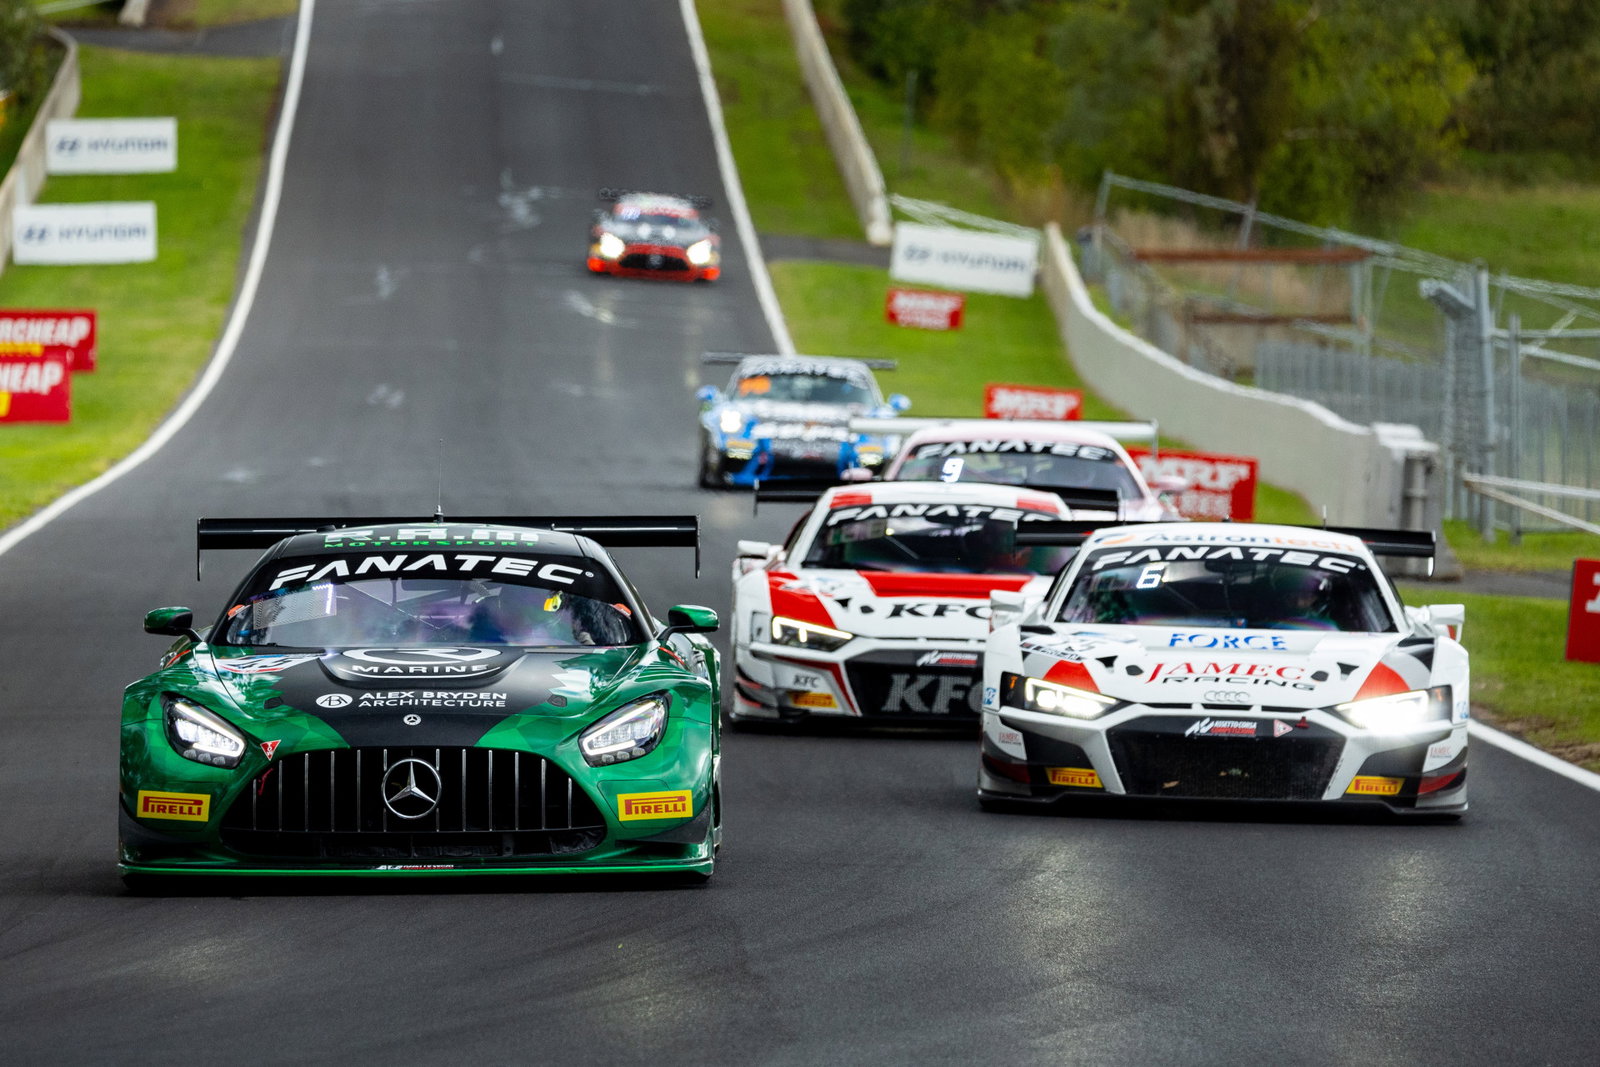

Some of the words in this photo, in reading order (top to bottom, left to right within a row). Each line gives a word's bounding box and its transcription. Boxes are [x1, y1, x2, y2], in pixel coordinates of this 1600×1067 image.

[941, 457, 965, 483] 9
[324, 539, 538, 548] MOTORSPORT
[1091, 546, 1357, 574] FANATEC
[269, 554, 583, 591] FANATEC
[1136, 564, 1168, 589] 6
[1169, 633, 1288, 651] FORCE
[351, 664, 489, 674] MARINE
[1145, 662, 1306, 684] JAMEC
[1162, 676, 1316, 692] RACING
[358, 699, 506, 708] ARCHITECTURE
[359, 692, 415, 700] ALEX
[423, 691, 507, 700] BRYDEN
[1051, 769, 1096, 786] PIRELLI
[142, 796, 204, 816] PIRELLI
[624, 795, 687, 815] PIRELLI
